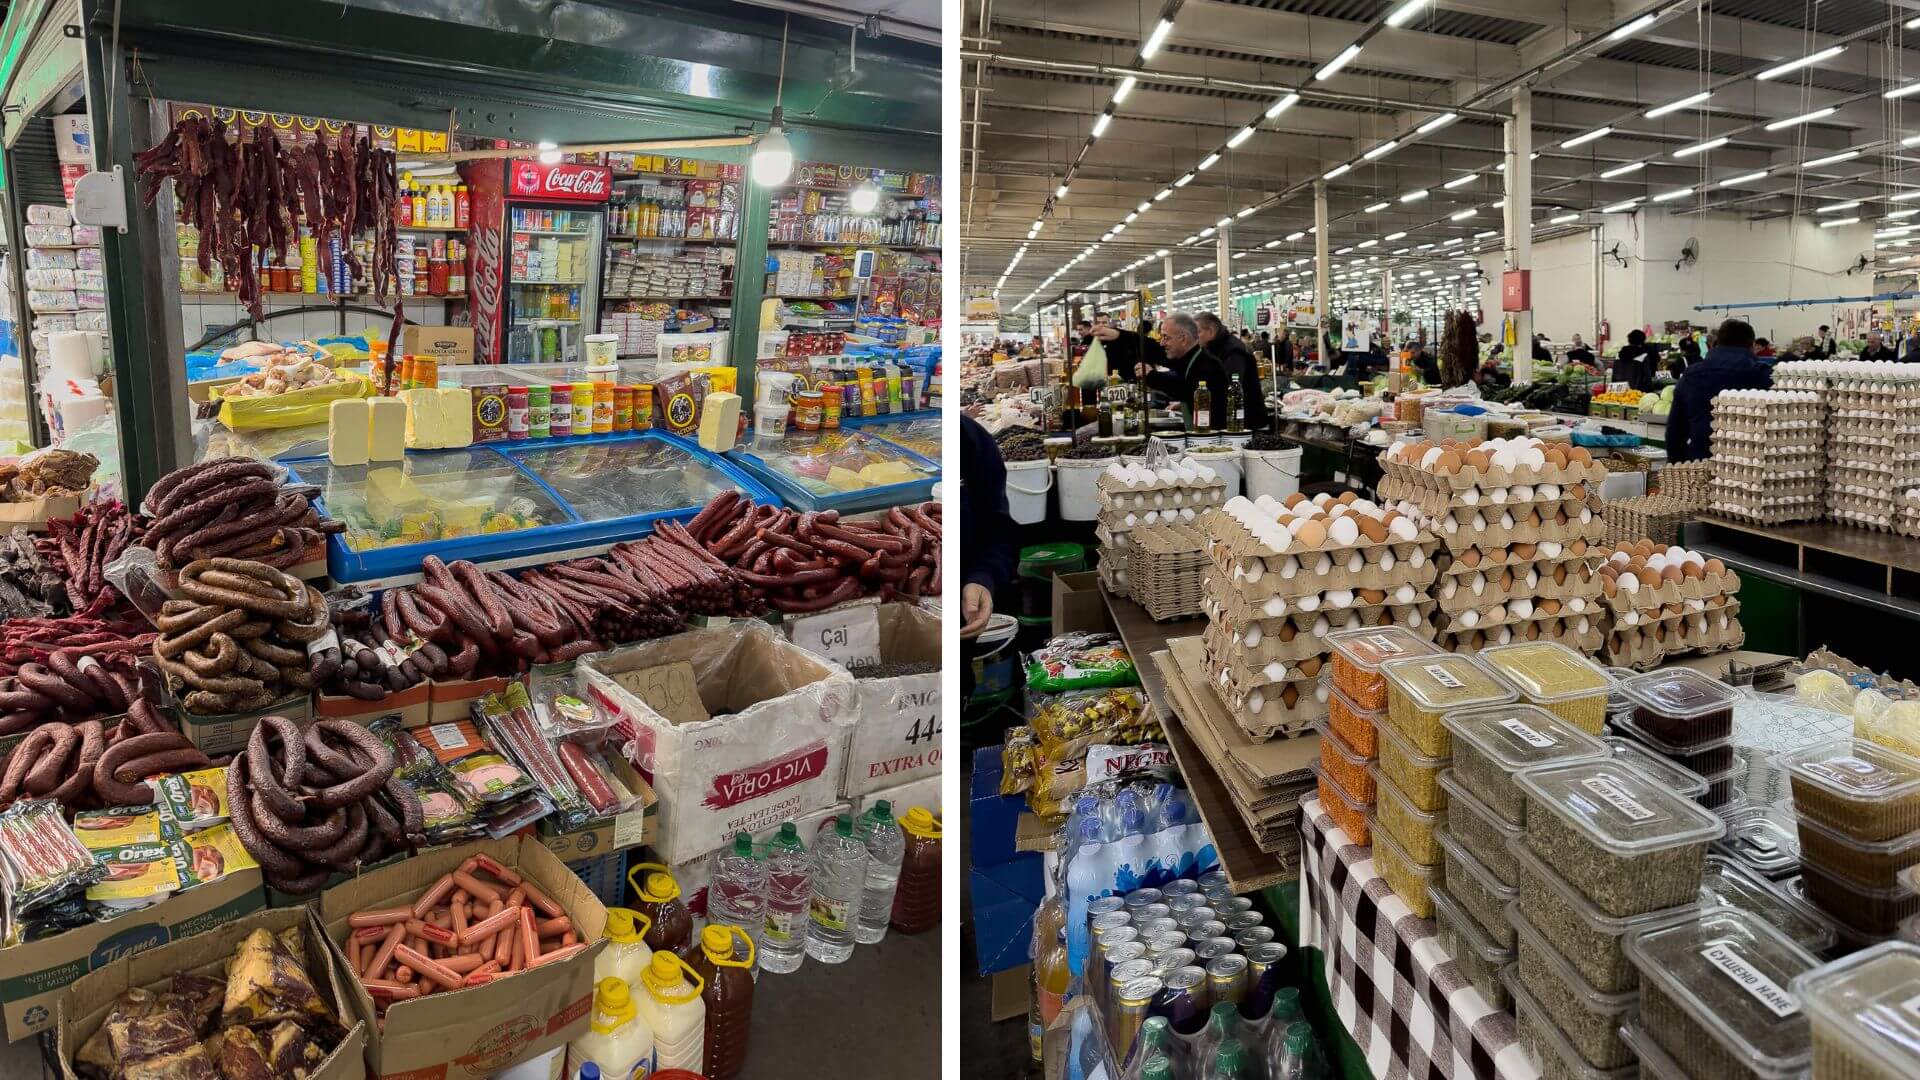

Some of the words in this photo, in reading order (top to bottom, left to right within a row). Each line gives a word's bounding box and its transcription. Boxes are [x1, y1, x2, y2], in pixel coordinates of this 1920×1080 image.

[545, 167, 606, 194] Coca-Cola
[1108, 388, 1126, 402] 320
[820, 625, 848, 650] Çaj
[868, 752, 923, 778] EXTRA
[723, 757, 812, 800] VICTORIA
[108, 805, 152, 815] Orex
[728, 815, 748, 830] TEA
[119, 847, 166, 860] Orex
[180, 913, 214, 930] МЕСНА
[100, 936, 158, 963] Tiamo
[24, 964, 79, 984] INDUSTRIA
[1709, 949, 1758, 985] СУШЕНО
[1756, 985, 1792, 1010] НАНЕ
